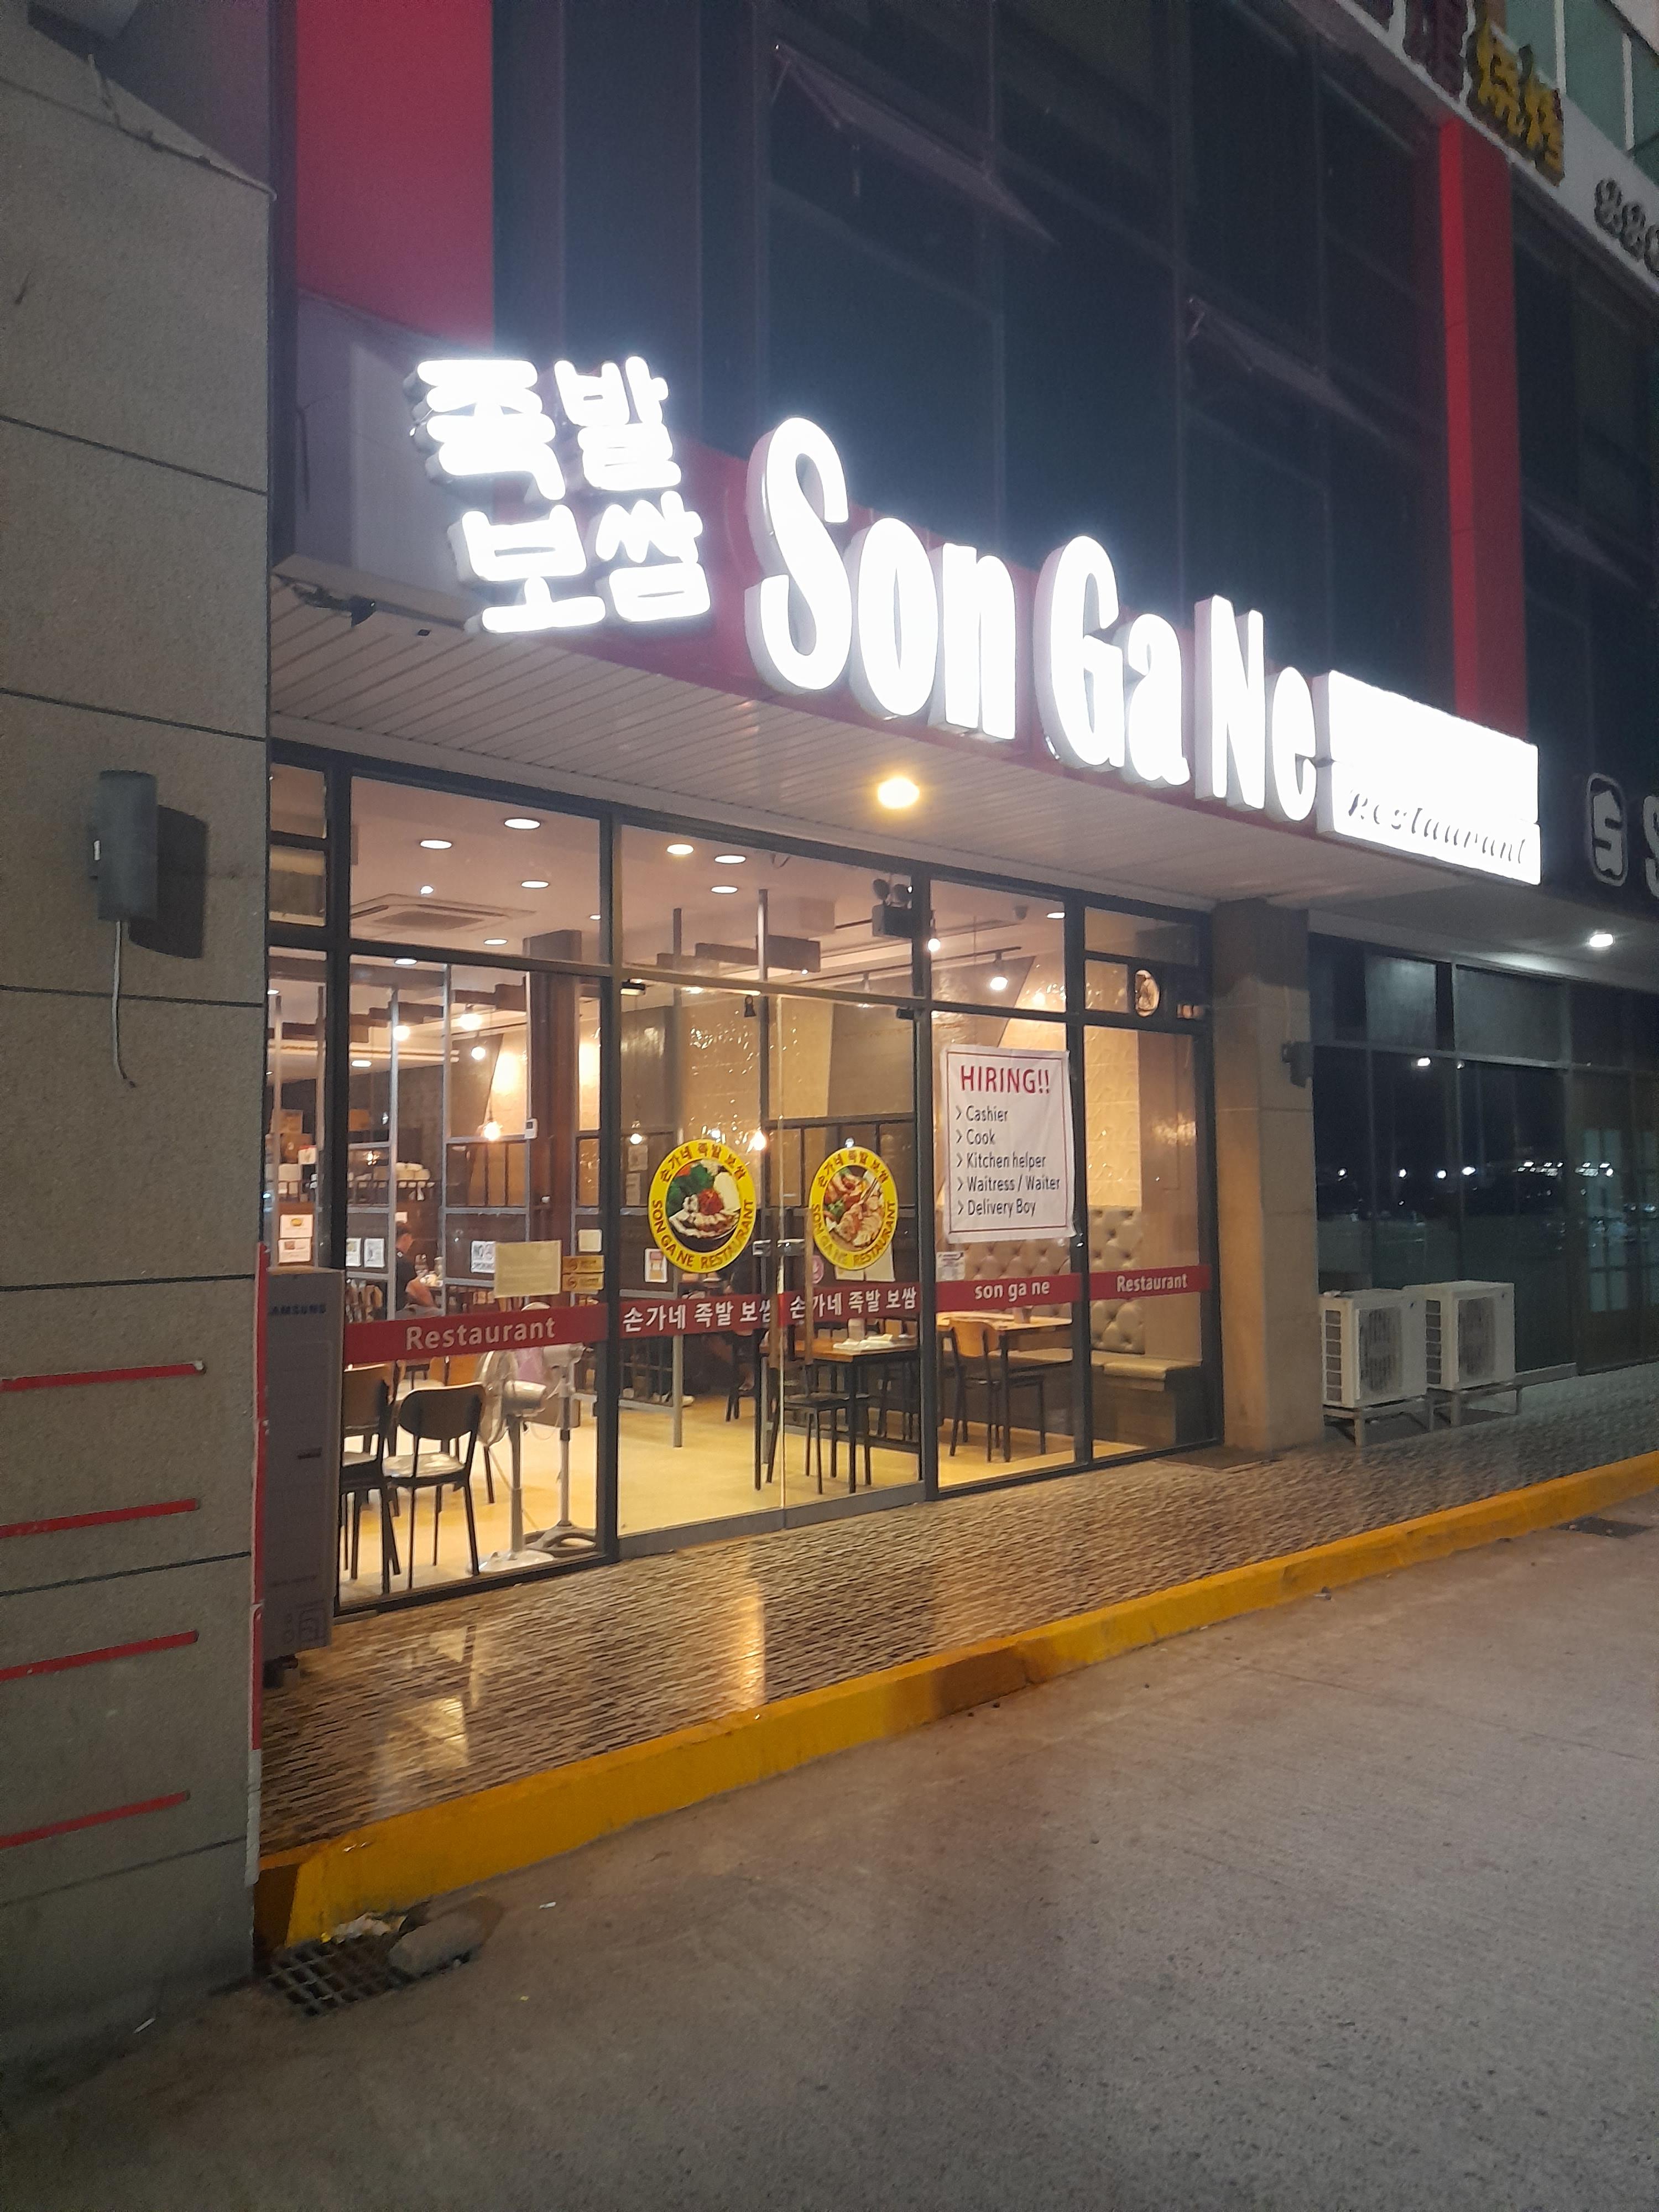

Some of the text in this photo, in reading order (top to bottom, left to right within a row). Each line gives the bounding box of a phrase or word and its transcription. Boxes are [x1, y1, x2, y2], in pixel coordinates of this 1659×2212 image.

[418, 356, 681, 500] 족발
[462, 491, 711, 633] 보쌈
[759, 417, 1317, 821] Son Ga Ne
[960, 1065, 1050, 1094] HIRING!!
[966, 1105, 1009, 1122] Cashier
[966, 1128, 995, 1145] Cook
[967, 1151, 1046, 1172] Kitchen helper
[967, 1175, 1015, 1192] Waitress
[1025, 1174, 1060, 1190] Waiter
[968, 1197, 1036, 1218] Delivery Boy
[652, 1199, 666, 1234] SON
[660, 1234, 677, 1256] GA
[676, 1250, 695, 1267] NE
[974, 1280, 1051, 1302] son ga ne
[1116, 1272, 1188, 1293] Restaurant
[623, 1303, 686, 1333] 손가네
[694, 1301, 734, 1328] 족발
[790, 1286, 917, 1319] 손가네 족발 보쌈
[405, 1317, 556, 1352] Restaurant
